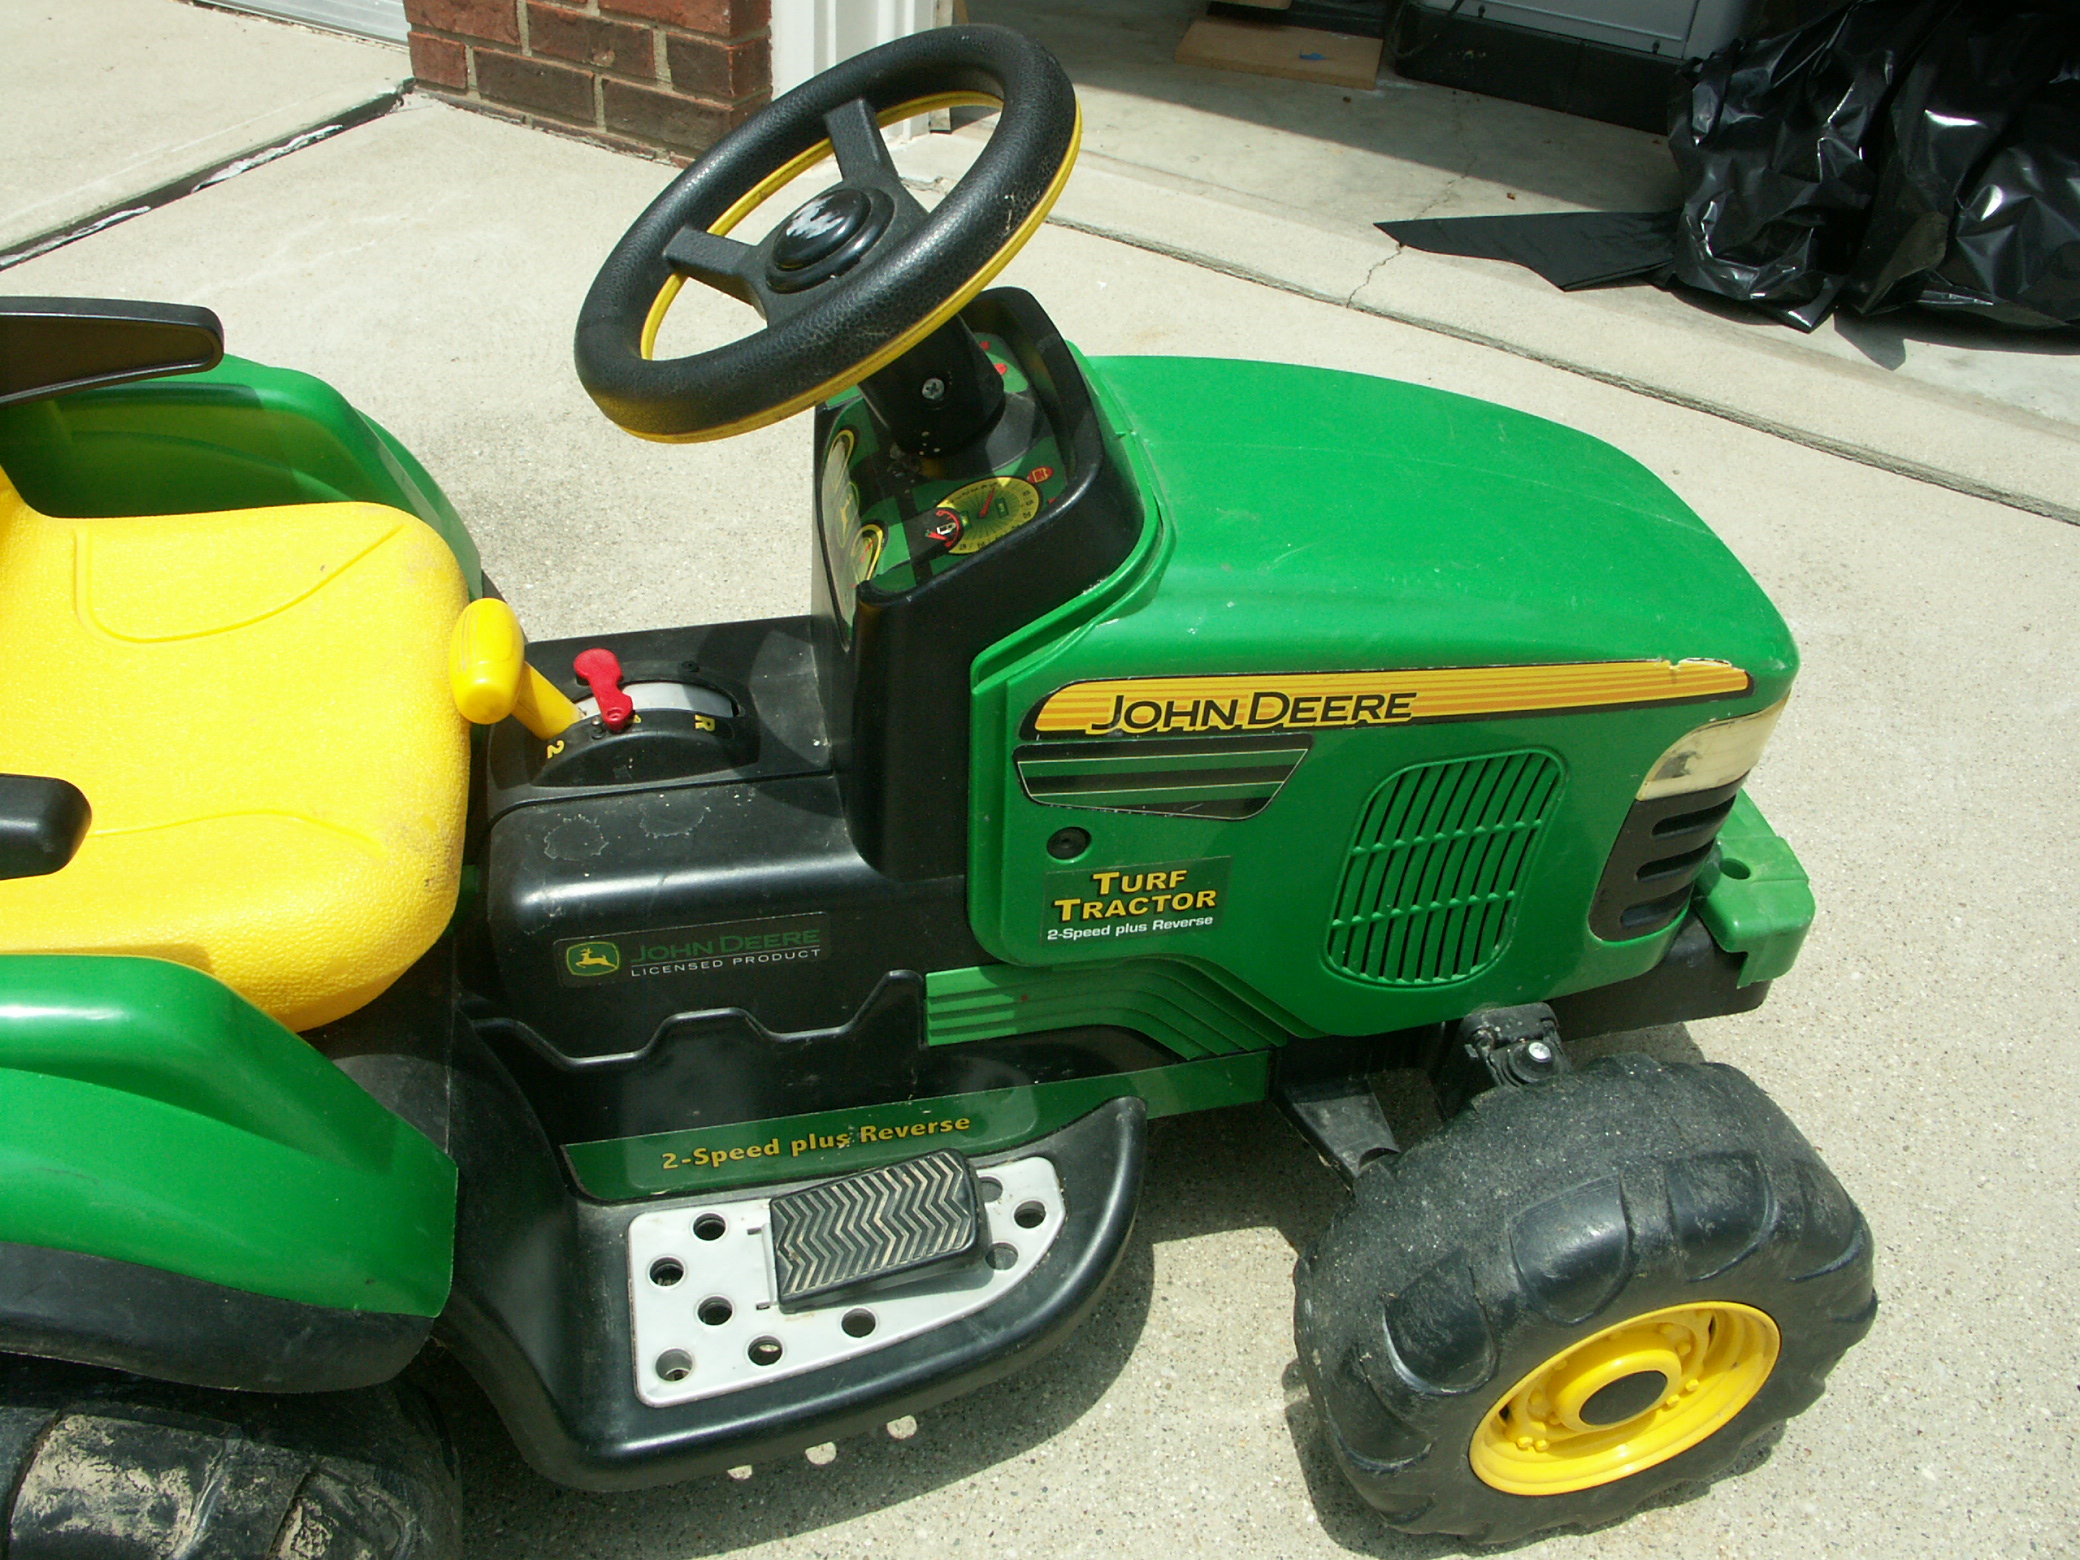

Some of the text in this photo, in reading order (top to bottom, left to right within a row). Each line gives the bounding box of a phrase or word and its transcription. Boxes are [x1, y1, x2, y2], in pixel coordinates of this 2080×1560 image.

[694, 713, 716, 732] R
[1091, 691, 1418, 731] JOHN DEERE
[546, 739, 566, 759] 2
[1092, 869, 1188, 895] TURF
[1053, 889, 1218, 922] TRACTOR
[1047, 916, 1214, 941] 2-Speed plus Reverse
[630, 929, 821, 963] JOHN DEERE
[631, 948, 821, 977] LICENSED PRODUCT
[661, 1116, 971, 1170] 2-Speed plus Reverse
